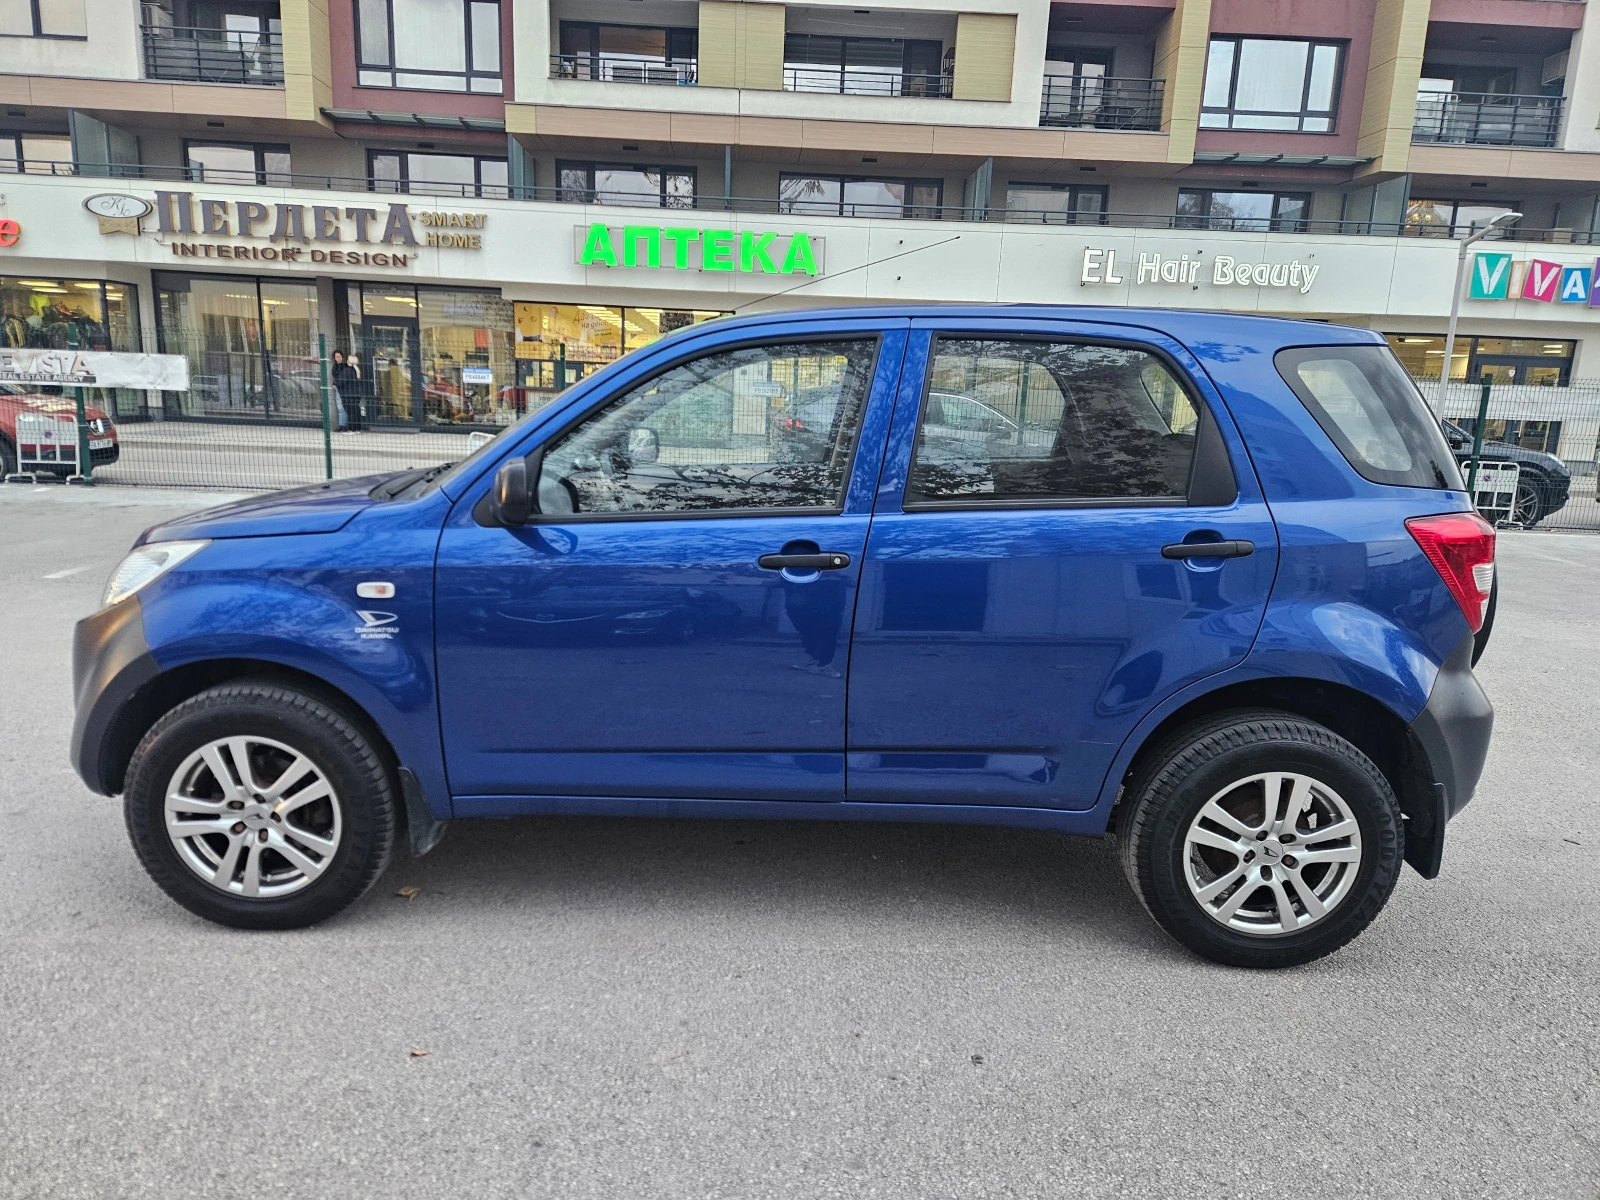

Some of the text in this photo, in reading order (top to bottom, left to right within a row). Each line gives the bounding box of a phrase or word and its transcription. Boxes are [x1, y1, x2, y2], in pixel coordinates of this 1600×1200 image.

[154, 190, 419, 246] ПЕРДЕТА
[419, 211, 487, 229] SMART
[172, 242, 407, 268] INTERIOR DESIGN
[425, 232, 482, 250] HOME
[580, 223, 818, 275] АПТЕКА
[1081, 249, 1319, 293] EL Hair Beauty
[1477, 256, 1600, 299] VIVA
[53, 375, 83, 383] AGENCY
